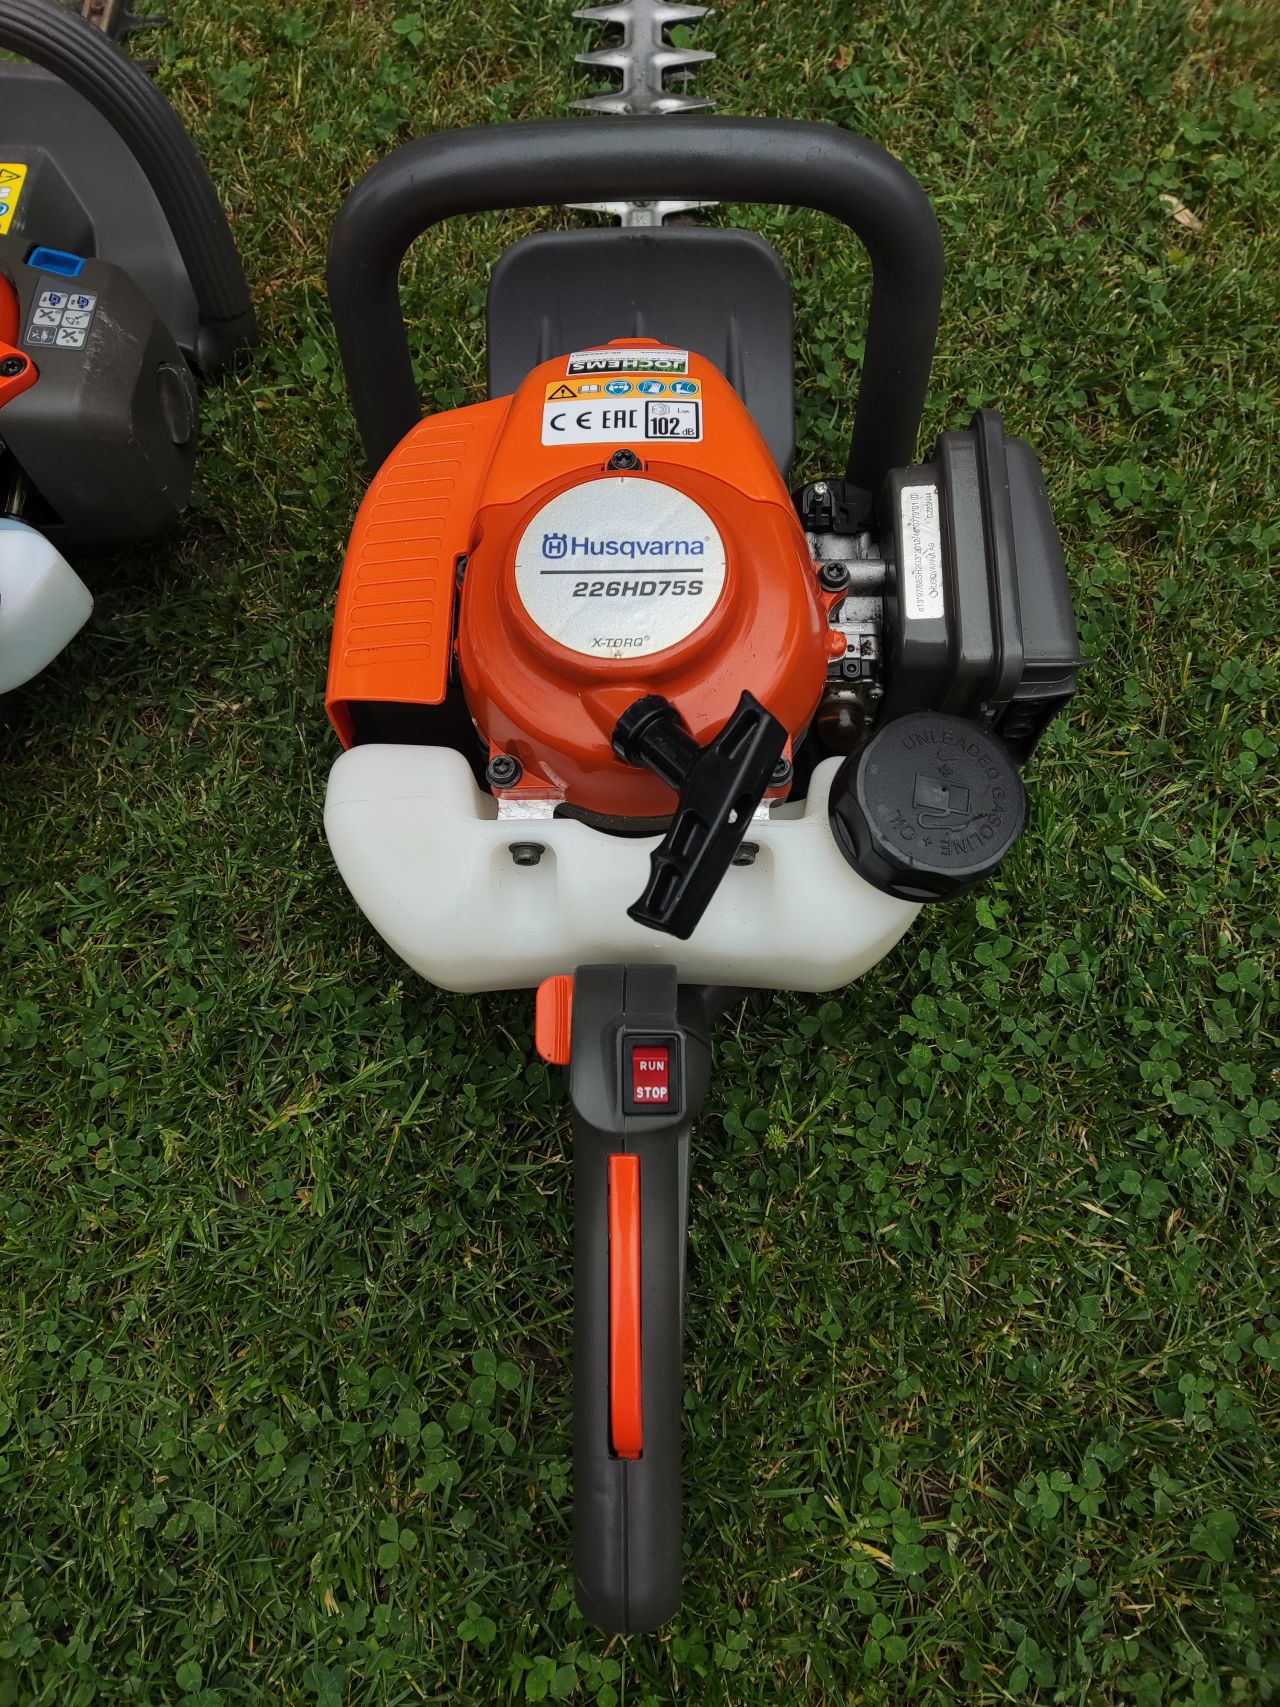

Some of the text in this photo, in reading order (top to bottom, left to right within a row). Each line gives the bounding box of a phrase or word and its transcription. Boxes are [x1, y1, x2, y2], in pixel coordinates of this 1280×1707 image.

[573, 359, 684, 370] JOCHEMS
[602, 410, 637, 428] EAC
[651, 417, 680, 435] 102
[571, 537, 704, 559] Husqvarna
[572, 580, 703, 597] 226HD75S
[901, 729, 999, 779] UNLEADED
[941, 787, 1006, 856] GASOLINE
[640, 1060, 664, 1071] RUN
[636, 1086, 668, 1099] STOP
